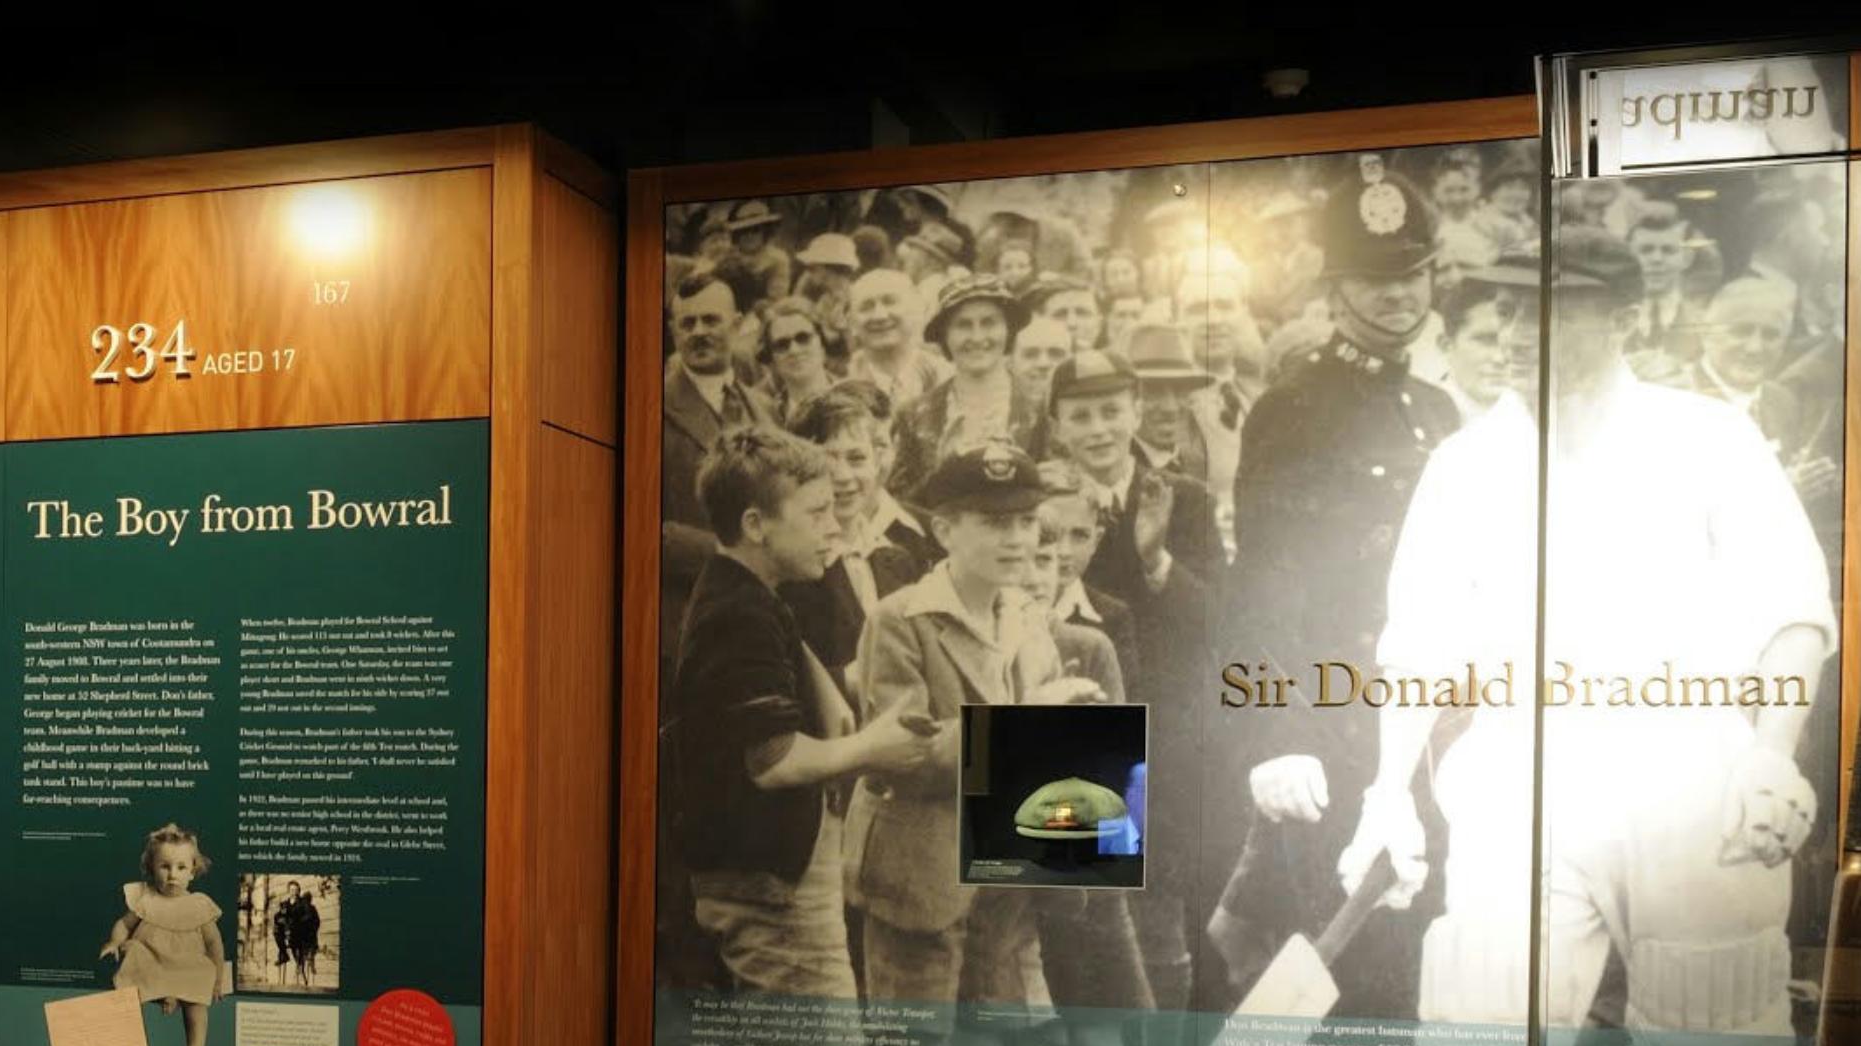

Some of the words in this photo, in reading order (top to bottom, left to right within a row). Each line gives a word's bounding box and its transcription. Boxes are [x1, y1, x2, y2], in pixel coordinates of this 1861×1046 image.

[312, 280, 351, 306] 167
[89, 318, 196, 385] 234
[202, 350, 265, 376] AGED
[271, 348, 297, 371] 17
[27, 499, 104, 539] The
[115, 497, 190, 547] Boy
[200, 494, 294, 534] from
[306, 485, 453, 530] Bowral
[1218, 661, 1296, 709] Sir
[1311, 661, 1516, 709] Donald
[1541, 659, 1812, 709] Bradman
